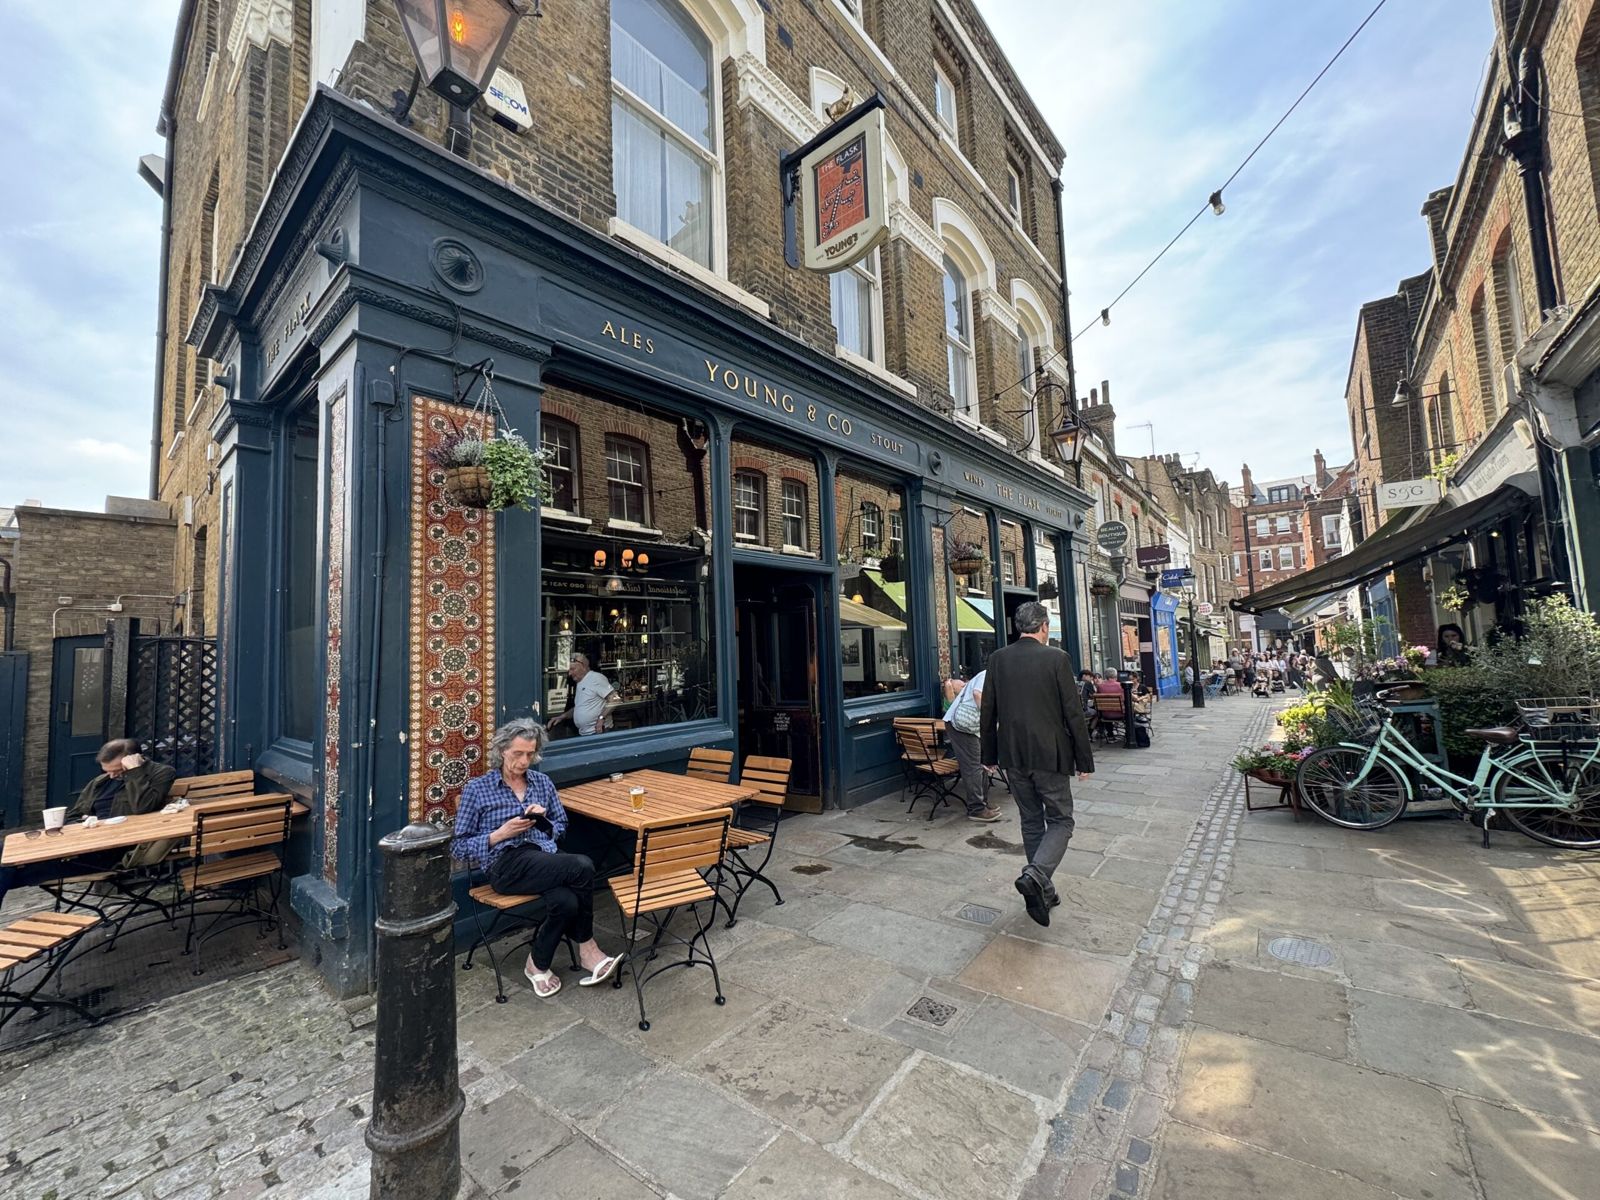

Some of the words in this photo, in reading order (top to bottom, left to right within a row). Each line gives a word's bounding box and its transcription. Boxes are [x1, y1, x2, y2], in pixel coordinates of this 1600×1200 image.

[489, 86, 527, 115] SECOM
[821, 159, 835, 174] THE
[836, 144, 860, 165] FLASK
[824, 232, 859, 257] YOUNG'S
[601, 320, 655, 355] ALES
[704, 359, 795, 414] YOUNG
[807, 403, 817, 423] &
[827, 413, 853, 437] CO
[870, 432, 905, 456] STOUT
[995, 483, 1014, 502] THE
[1018, 492, 1041, 513] FLASK
[1097, 531, 1127, 539] BOUTIQUE
[1100, 525, 1124, 533] BEAUTY
